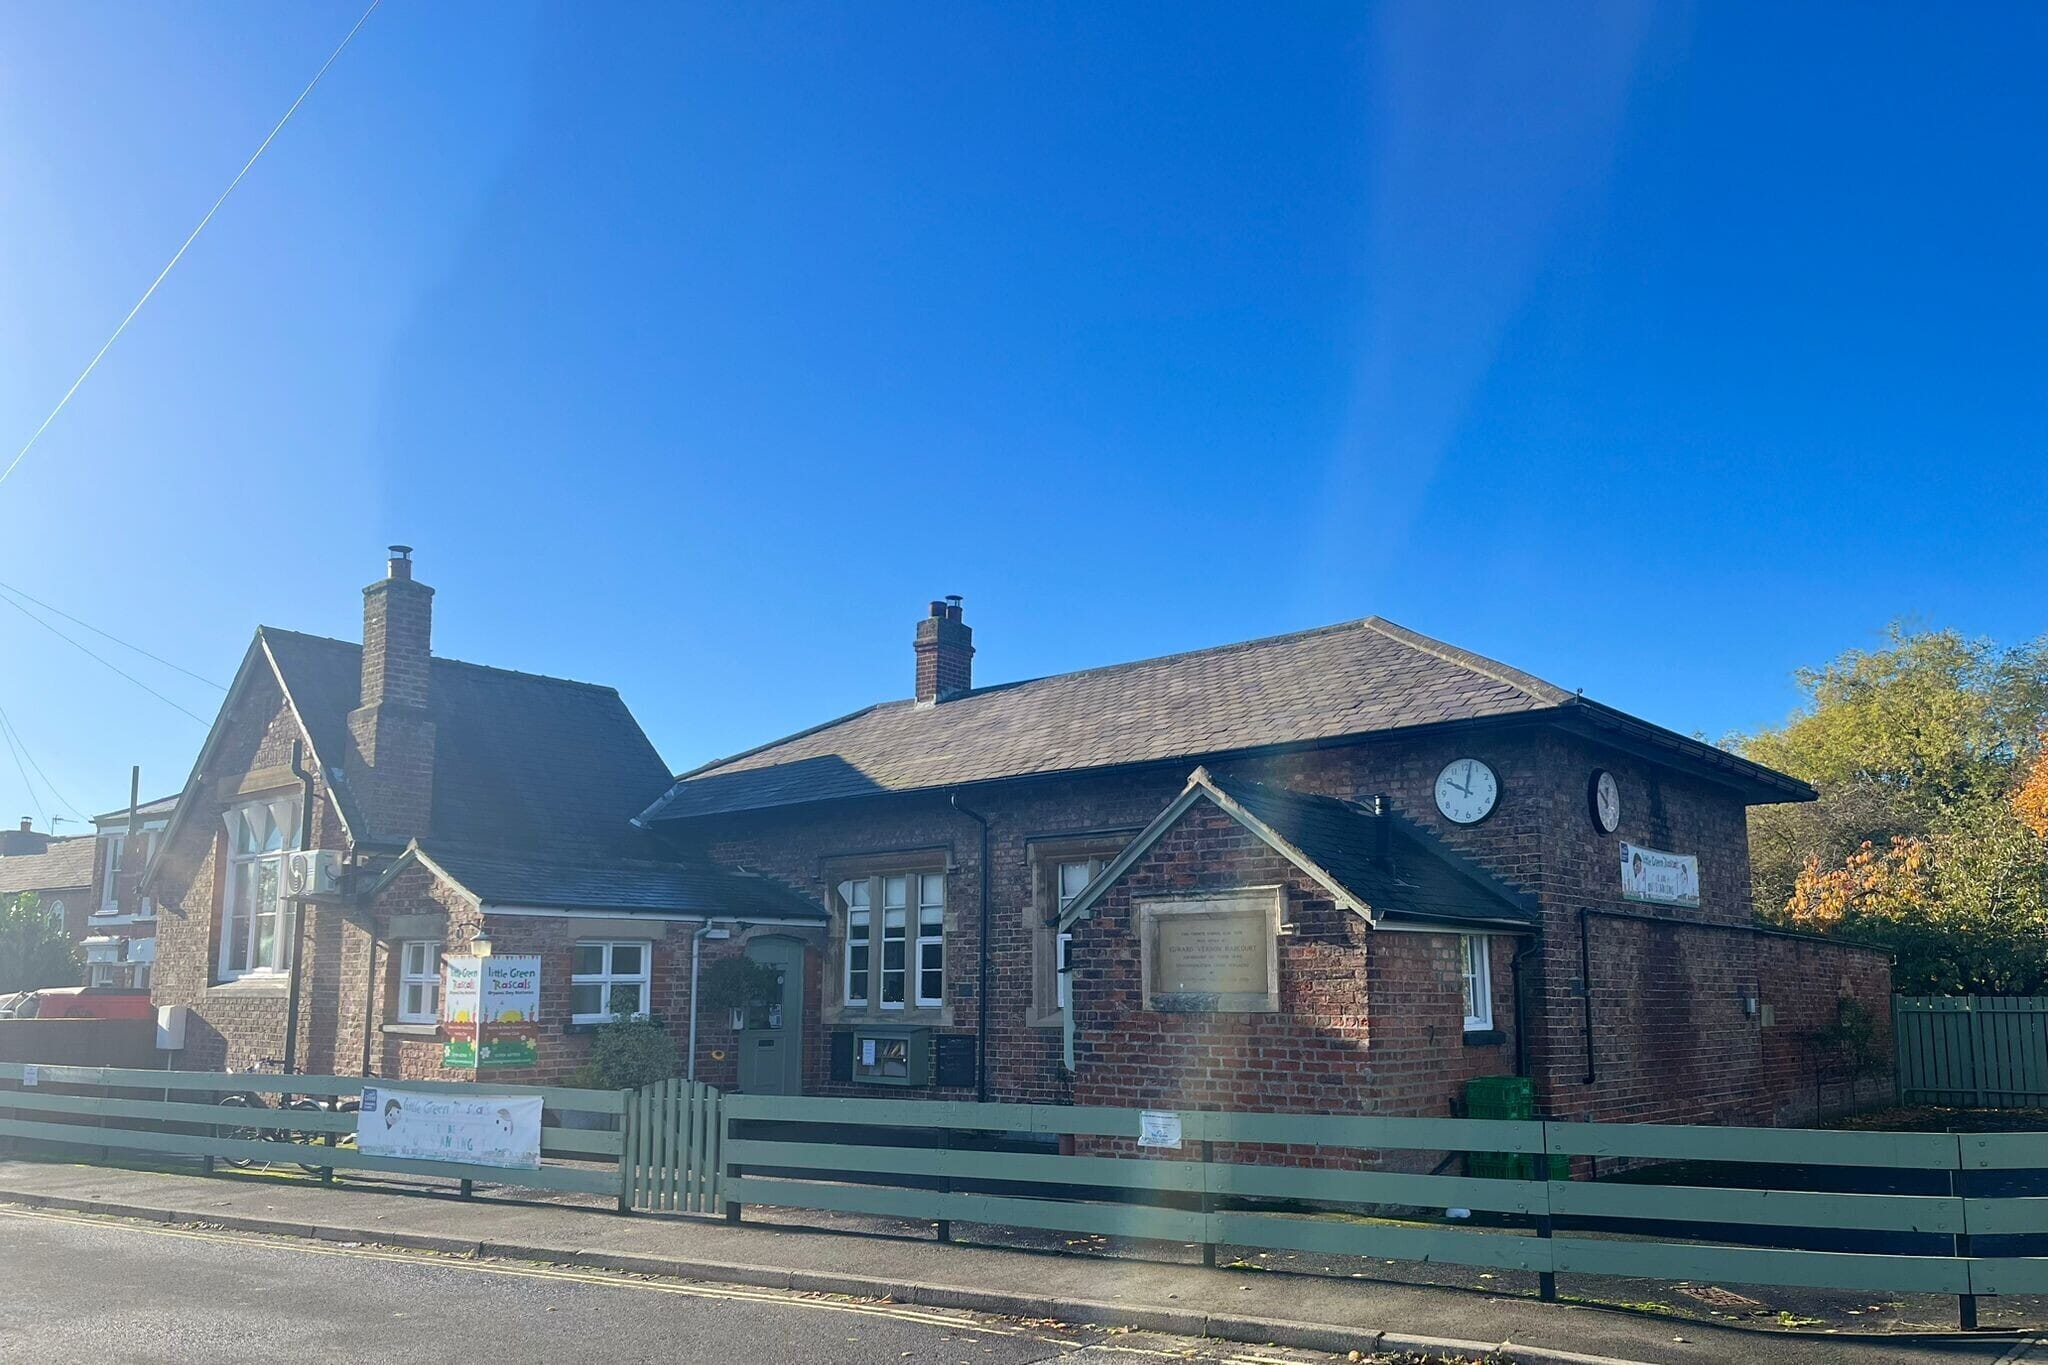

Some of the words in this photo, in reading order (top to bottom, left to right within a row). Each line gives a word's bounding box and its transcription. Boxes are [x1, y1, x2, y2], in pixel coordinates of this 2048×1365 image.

[1451, 768, 1457, 776] 11
[1484, 773, 1489, 781] 2
[1445, 801, 1451, 809] 8
[1465, 811, 1471, 819] 6
[510, 967, 536, 979] Green
[492, 979, 532, 990] Rascals
[423, 1100, 450, 1115] Green
